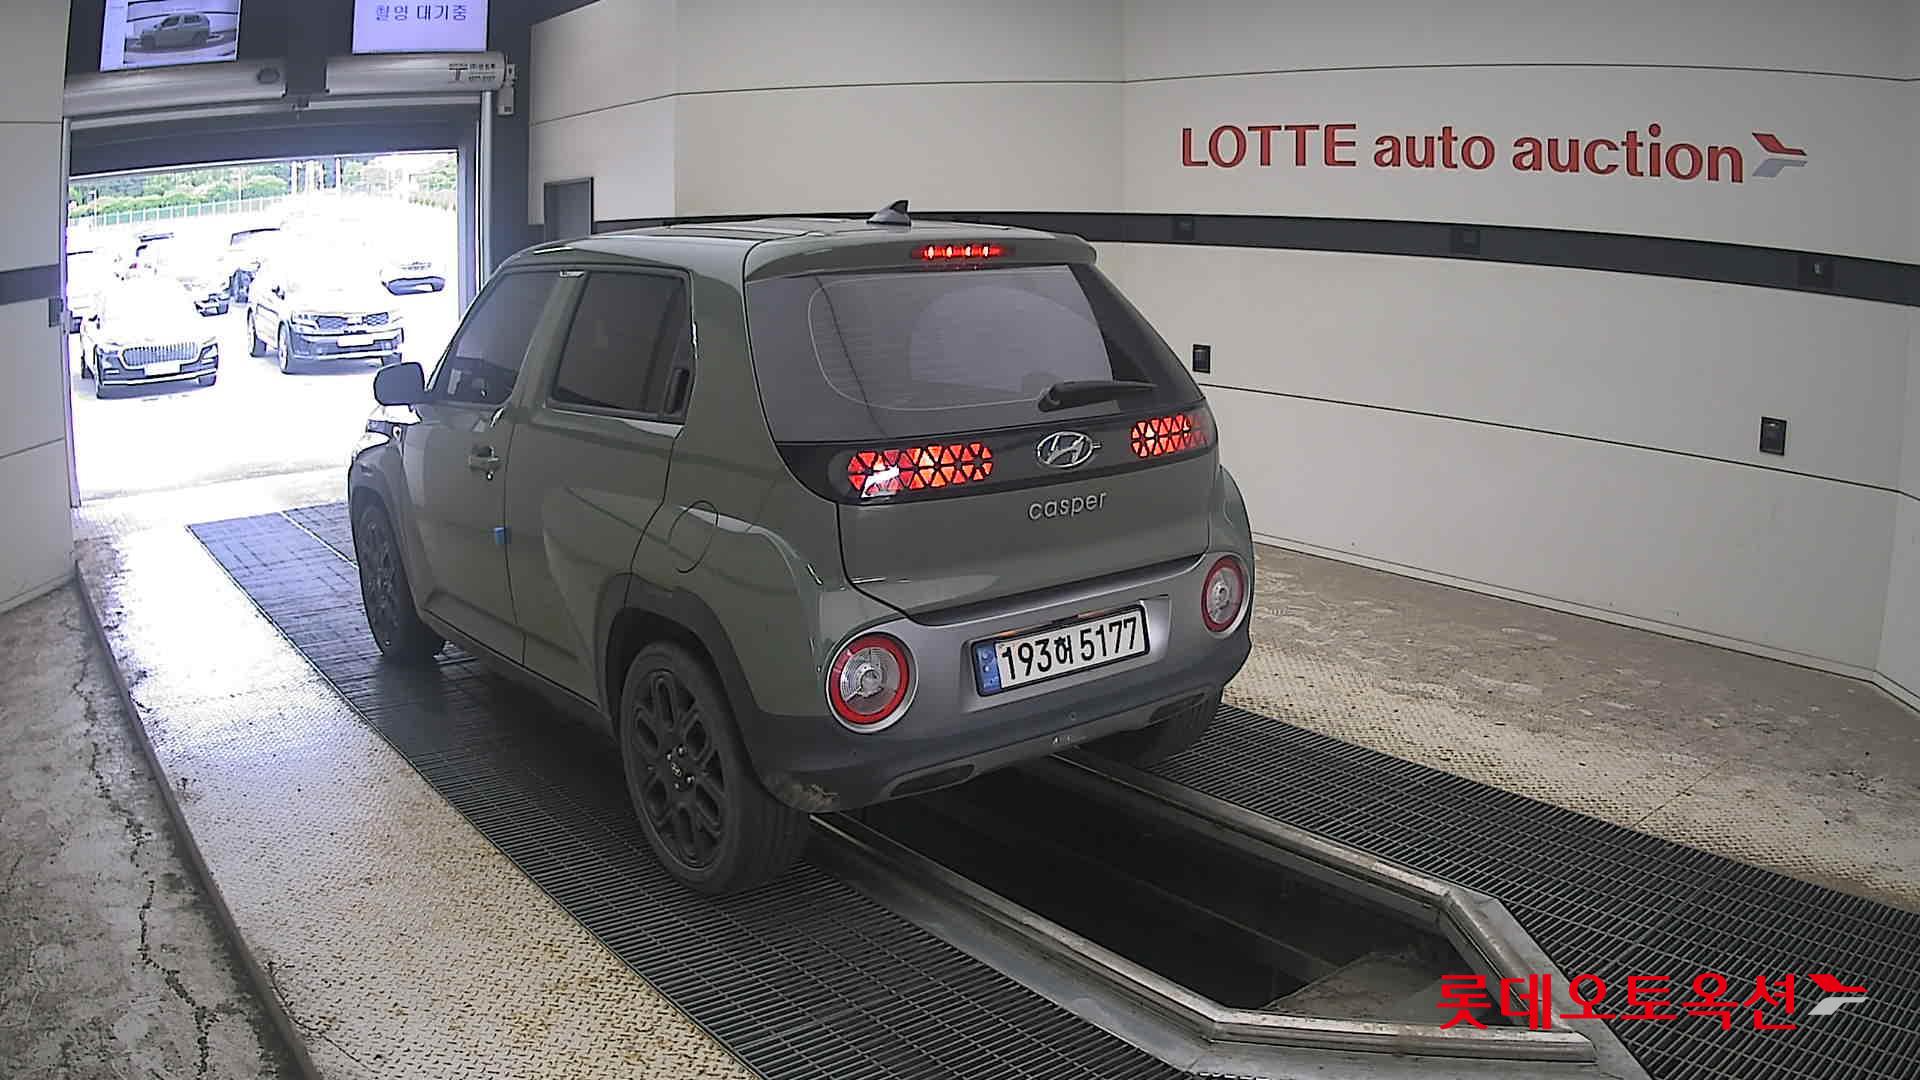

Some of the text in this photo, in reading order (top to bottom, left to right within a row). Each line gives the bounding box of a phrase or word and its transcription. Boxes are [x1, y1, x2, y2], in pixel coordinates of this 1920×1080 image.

[416, 5, 468, 21] 대기중
[1182, 123, 1744, 183] LOTTE auto auction
[1028, 492, 1106, 519] casper
